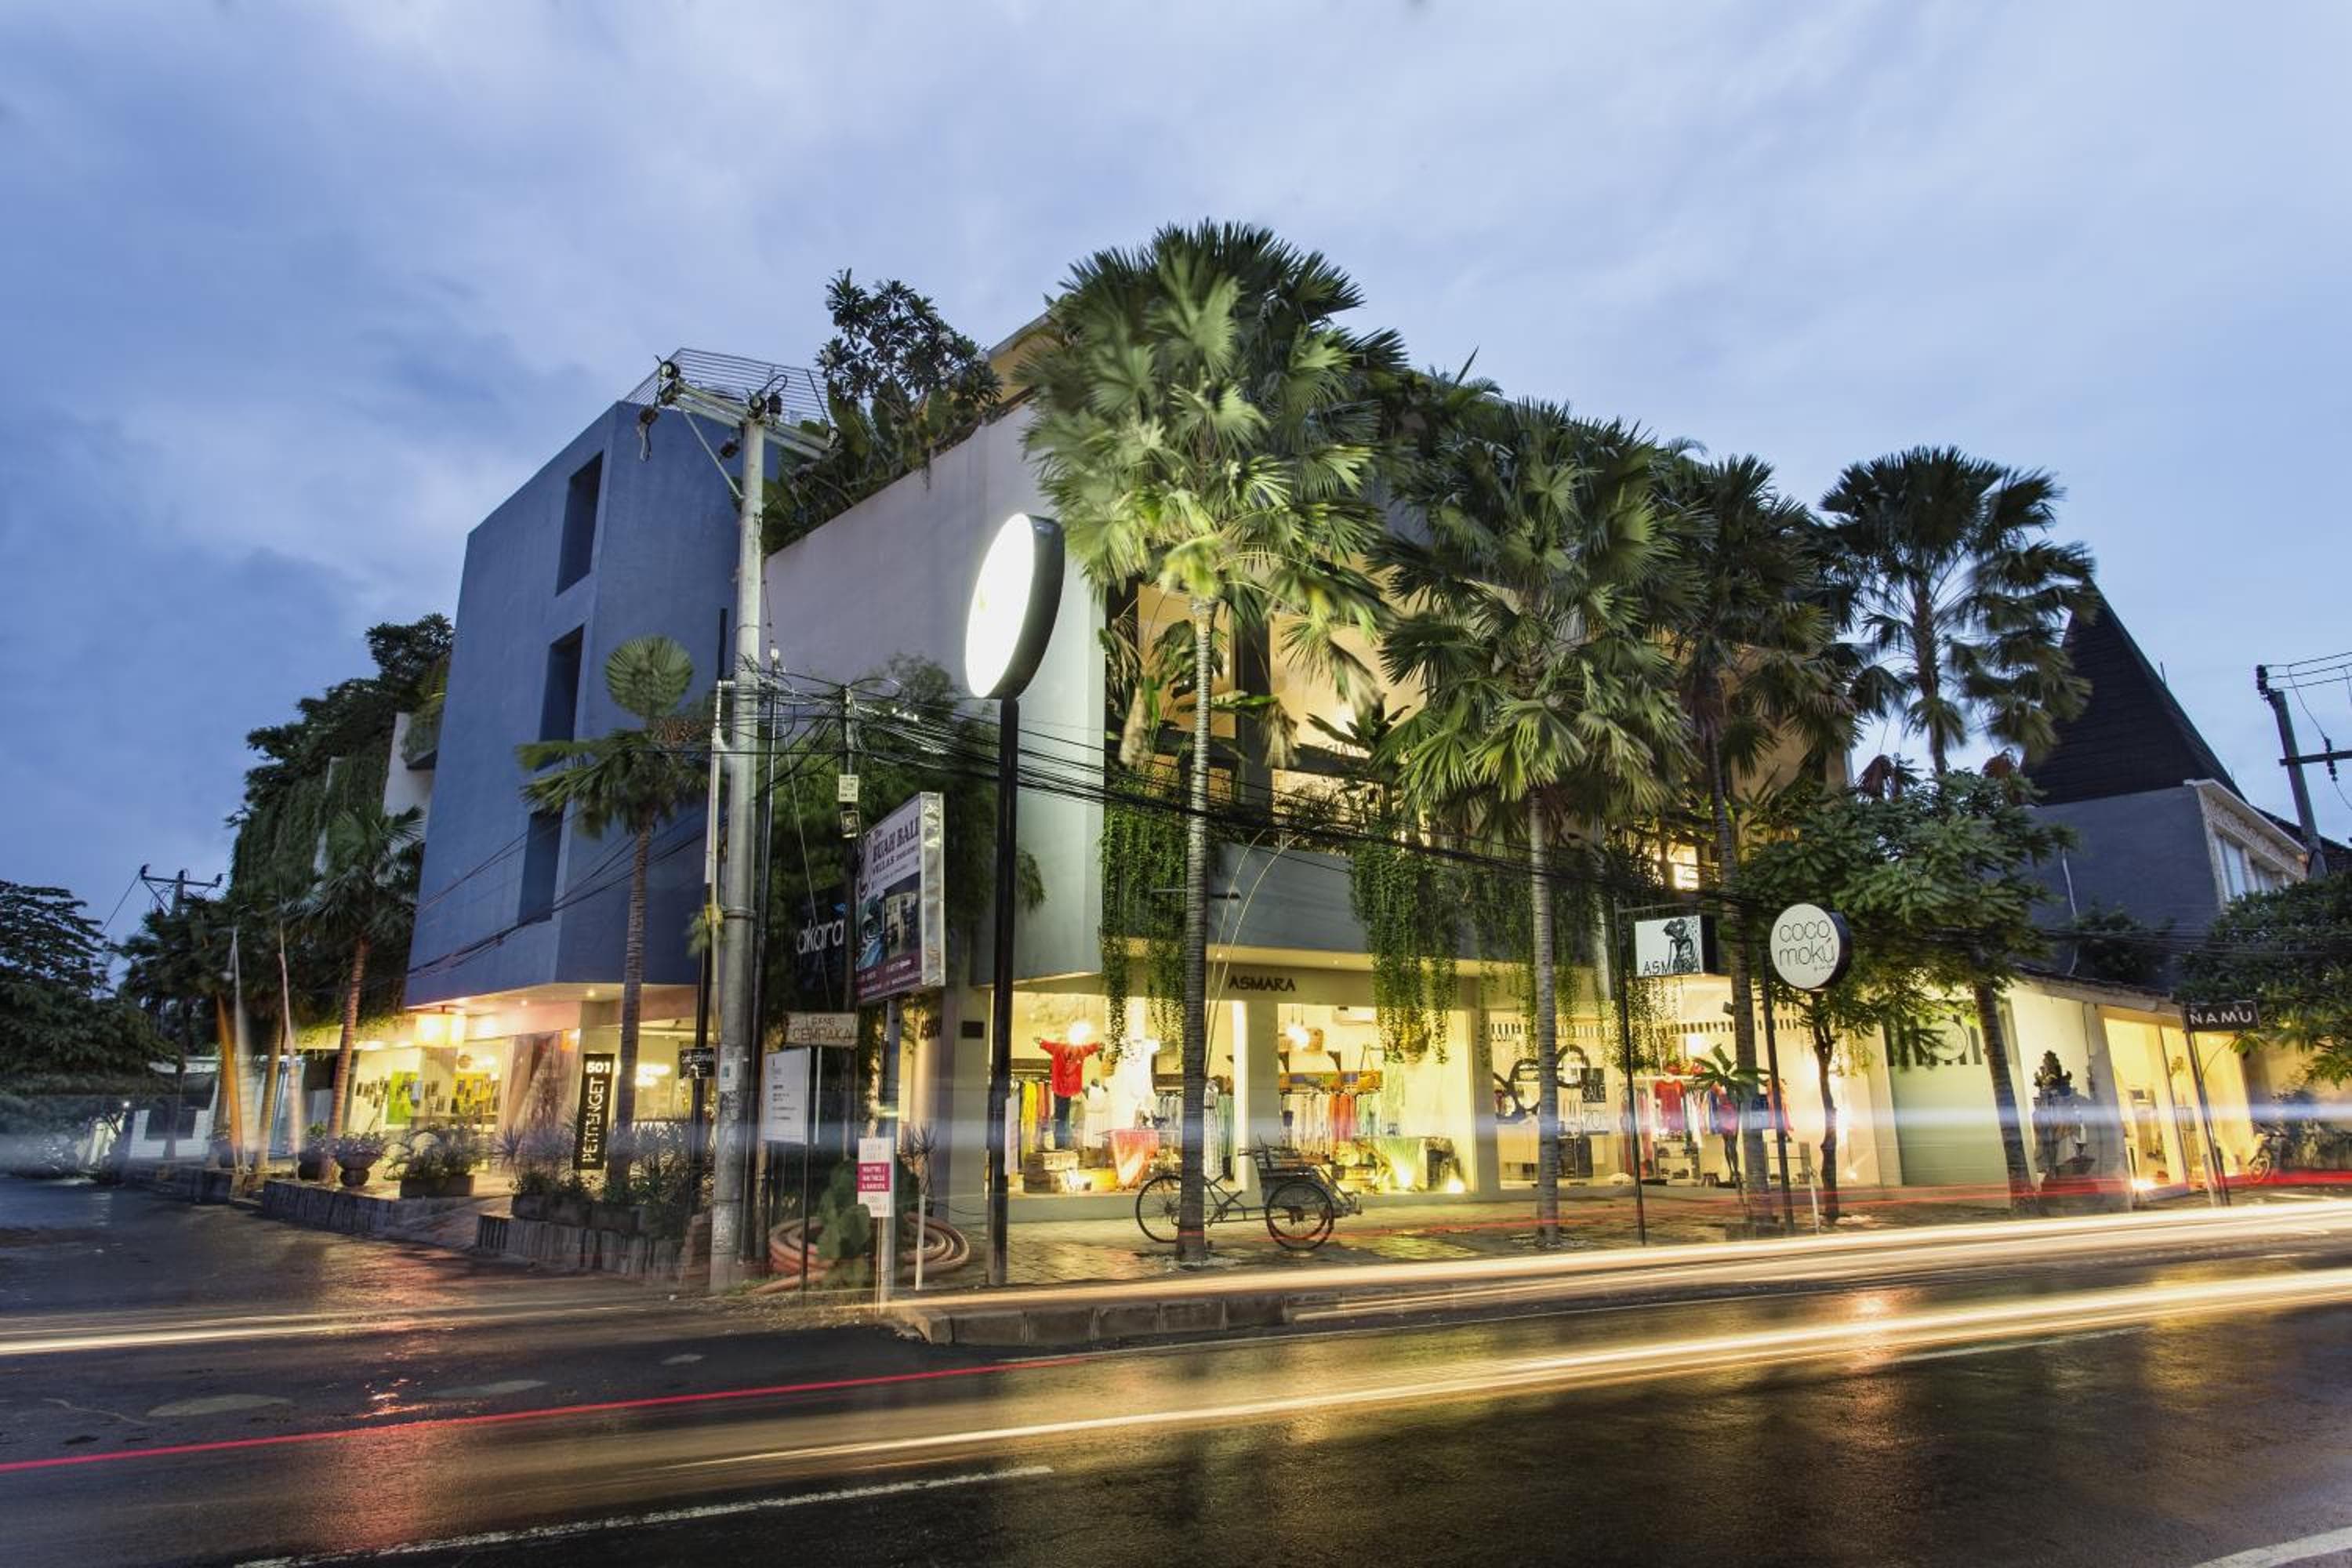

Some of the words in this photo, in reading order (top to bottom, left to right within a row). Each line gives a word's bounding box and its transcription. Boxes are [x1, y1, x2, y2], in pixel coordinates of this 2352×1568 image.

[896, 816, 920, 848] BALI
[797, 918, 844, 955] akara
[1779, 920, 1831, 943] coco
[1229, 975, 1296, 992] ASMARA
[2189, 1010, 2252, 1024] NAMU
[586, 1061, 612, 1074] 501
[581, 1076, 605, 1163] PETITENGET
